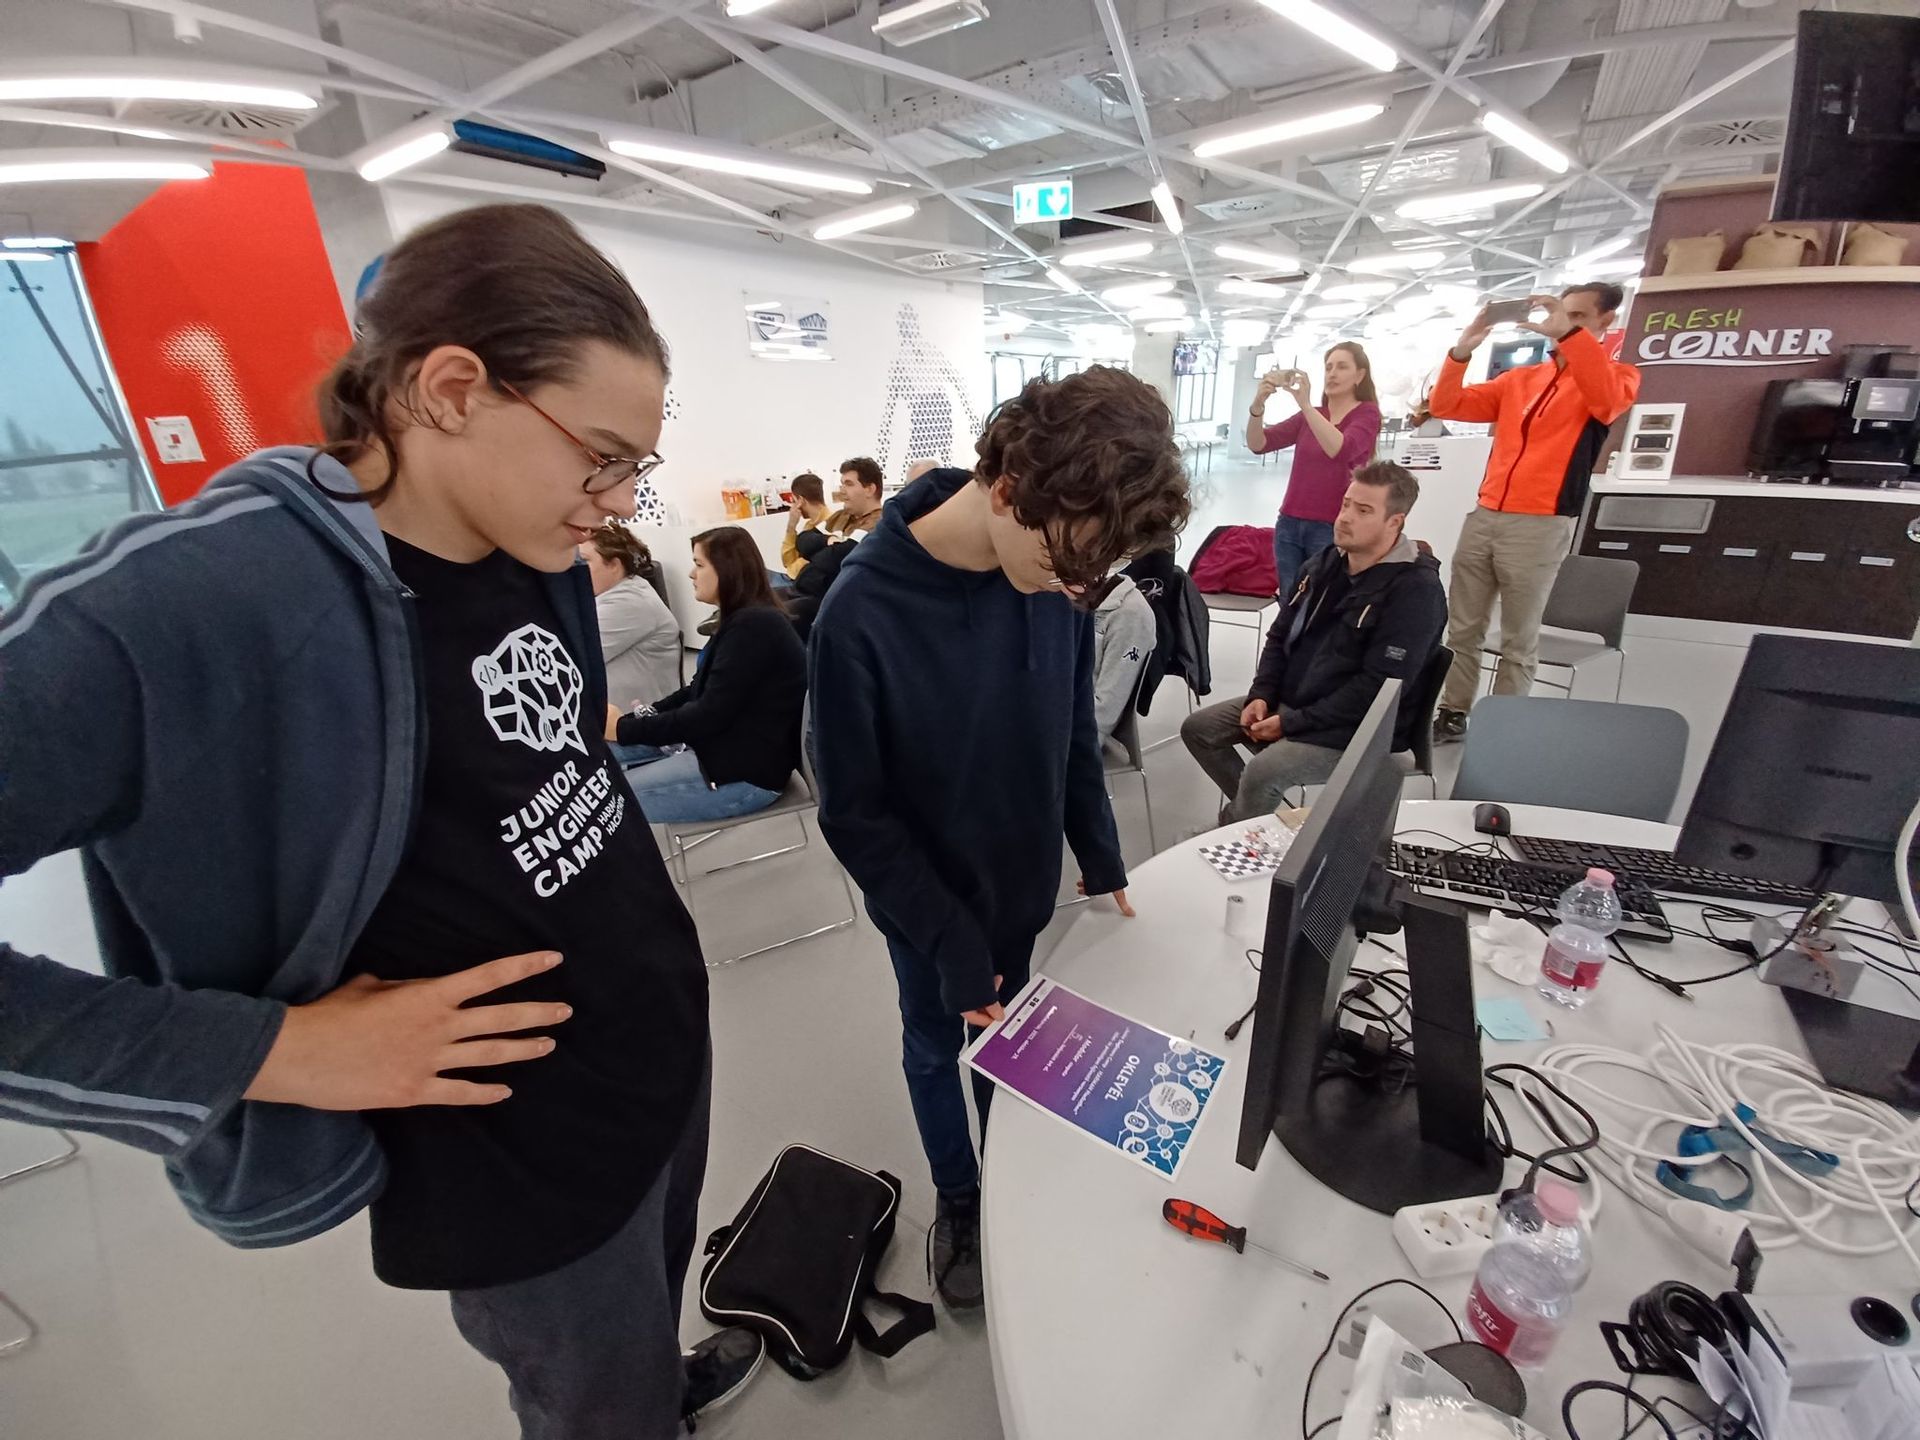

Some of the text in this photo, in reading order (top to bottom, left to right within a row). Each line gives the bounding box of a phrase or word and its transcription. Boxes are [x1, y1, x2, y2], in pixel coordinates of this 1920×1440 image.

[1638, 328, 1832, 360] CORNER
[1644, 308, 1743, 332] FRESH
[500, 760, 581, 843] JUNIOR
[511, 759, 612, 873] ENGINEER
[533, 825, 604, 898] CAMP
[1104, 1054, 1141, 1101] OKLEVÉL
